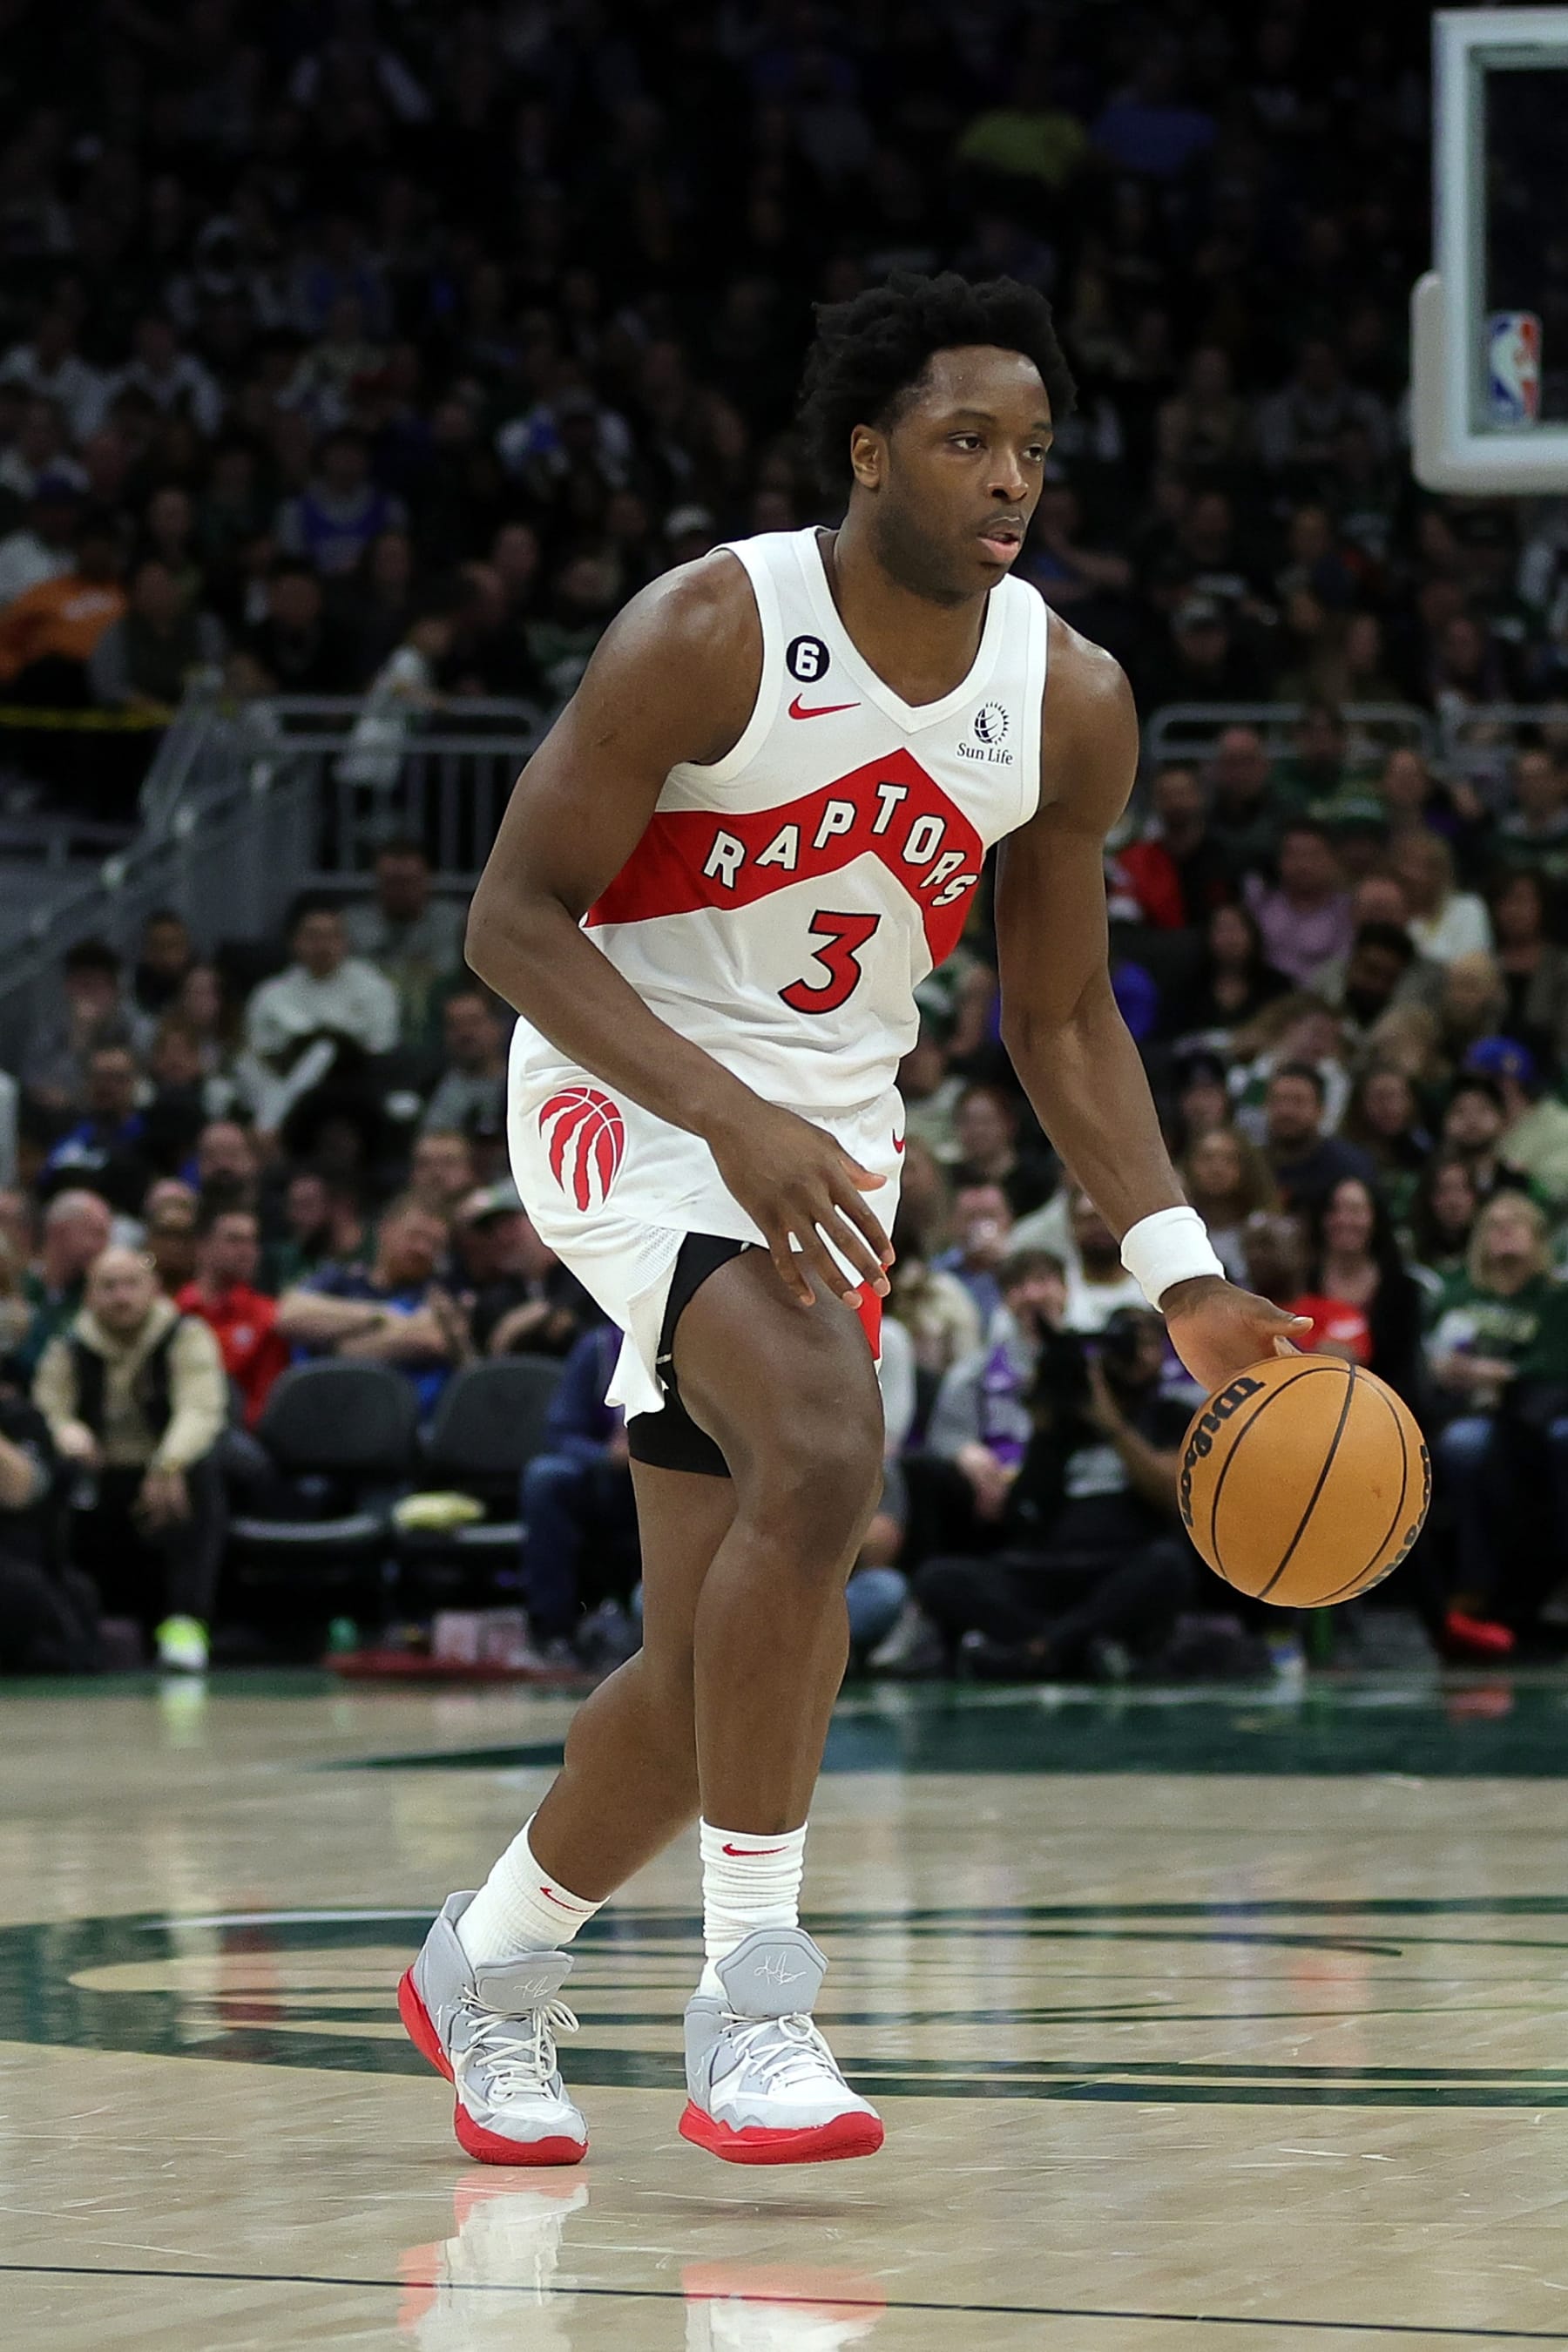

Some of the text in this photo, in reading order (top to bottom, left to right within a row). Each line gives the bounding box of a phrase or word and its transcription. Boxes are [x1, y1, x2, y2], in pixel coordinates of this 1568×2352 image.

[794, 644, 820, 678] 6
[956, 743, 1014, 765] Sun Life
[703, 783, 980, 908] RAPTORS
[778, 910, 882, 1015] 3
